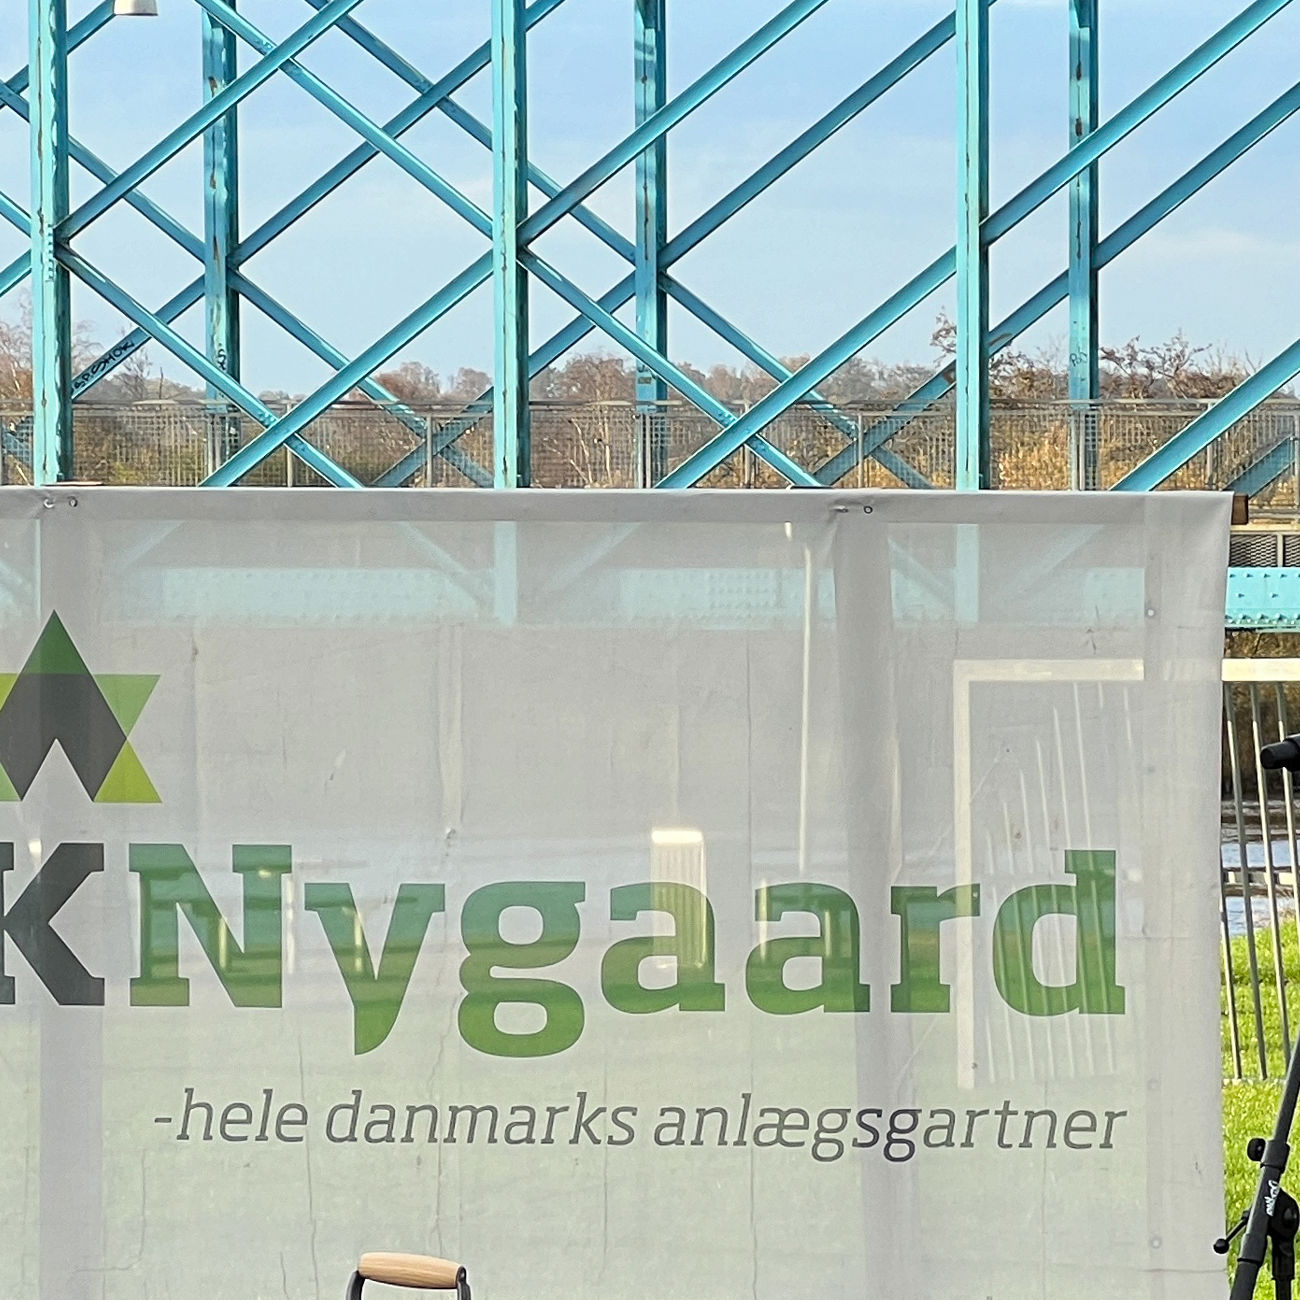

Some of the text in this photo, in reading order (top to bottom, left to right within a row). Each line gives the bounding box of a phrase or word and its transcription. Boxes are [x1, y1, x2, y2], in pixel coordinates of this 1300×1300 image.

[154, 1088, 1127, 1163] -hele danmarks anlægsgartner
